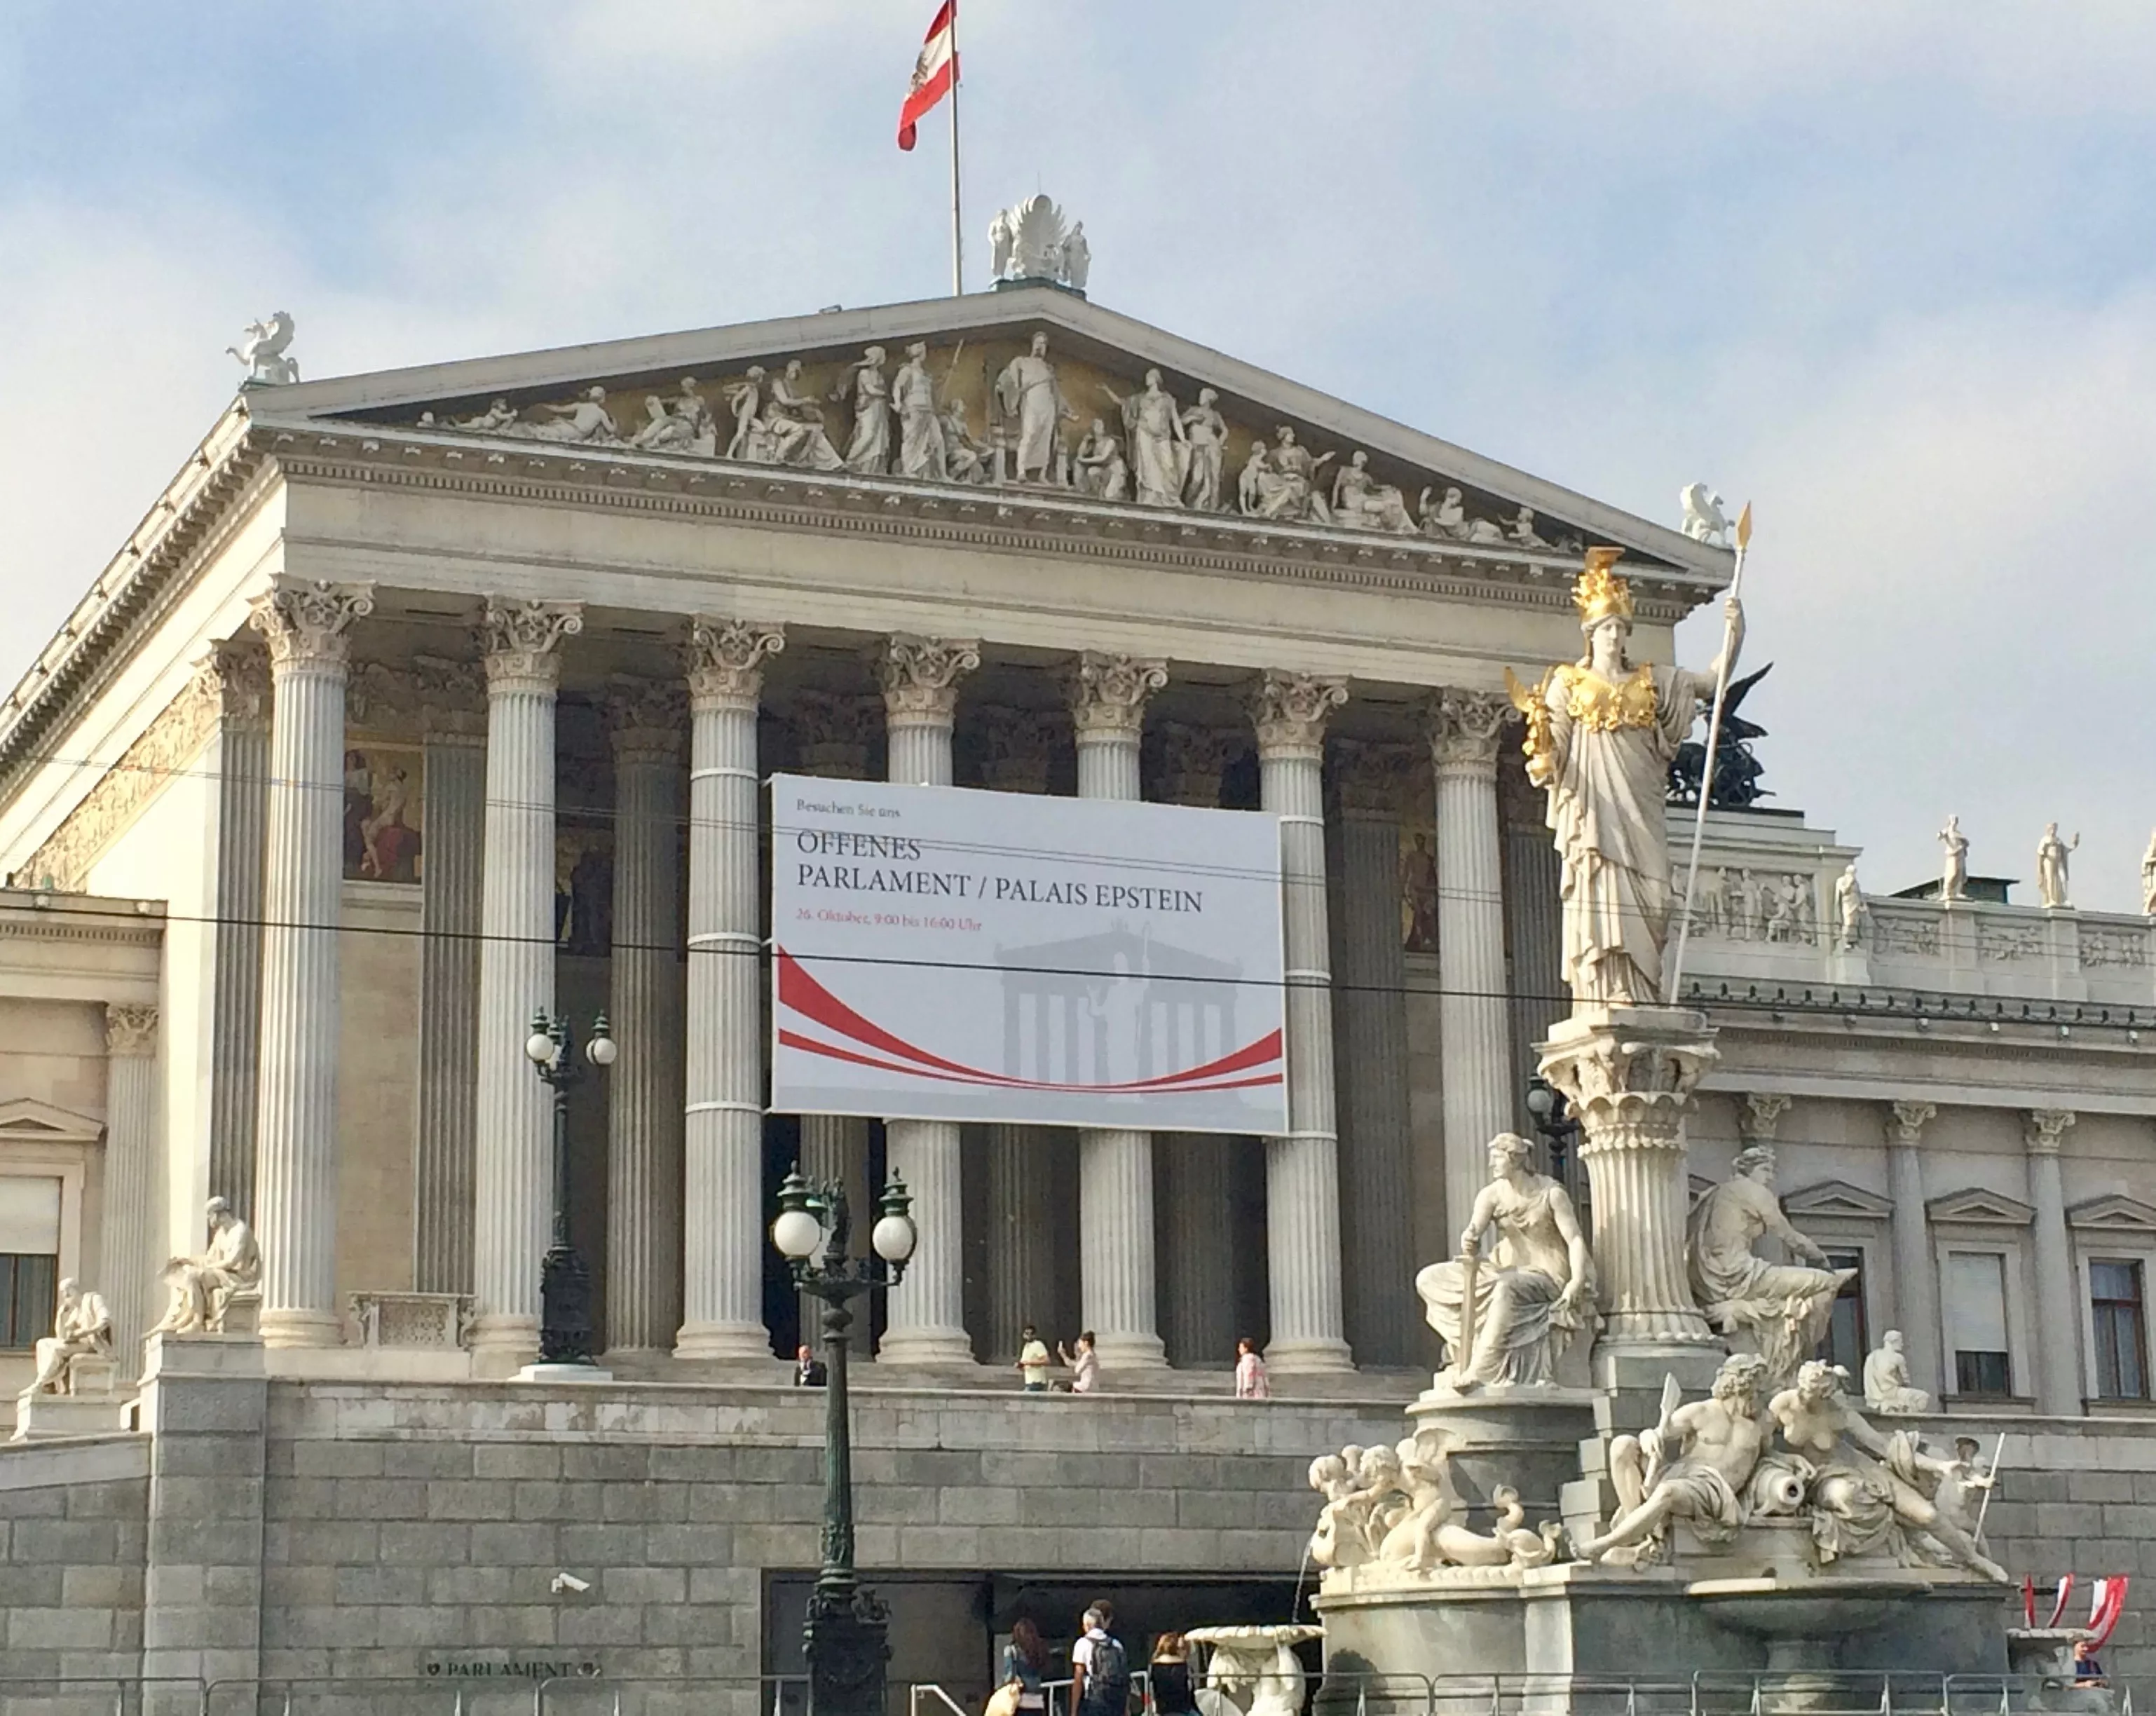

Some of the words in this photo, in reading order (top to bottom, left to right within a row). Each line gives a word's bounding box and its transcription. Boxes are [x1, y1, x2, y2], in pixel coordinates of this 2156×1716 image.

[797, 798, 854, 815] Besuchen
[797, 829, 922, 861] OFFENES
[798, 863, 971, 897] PARLAMENT
[995, 877, 1088, 906] PALAIS
[1095, 884, 1203, 913] EPSTEIN
